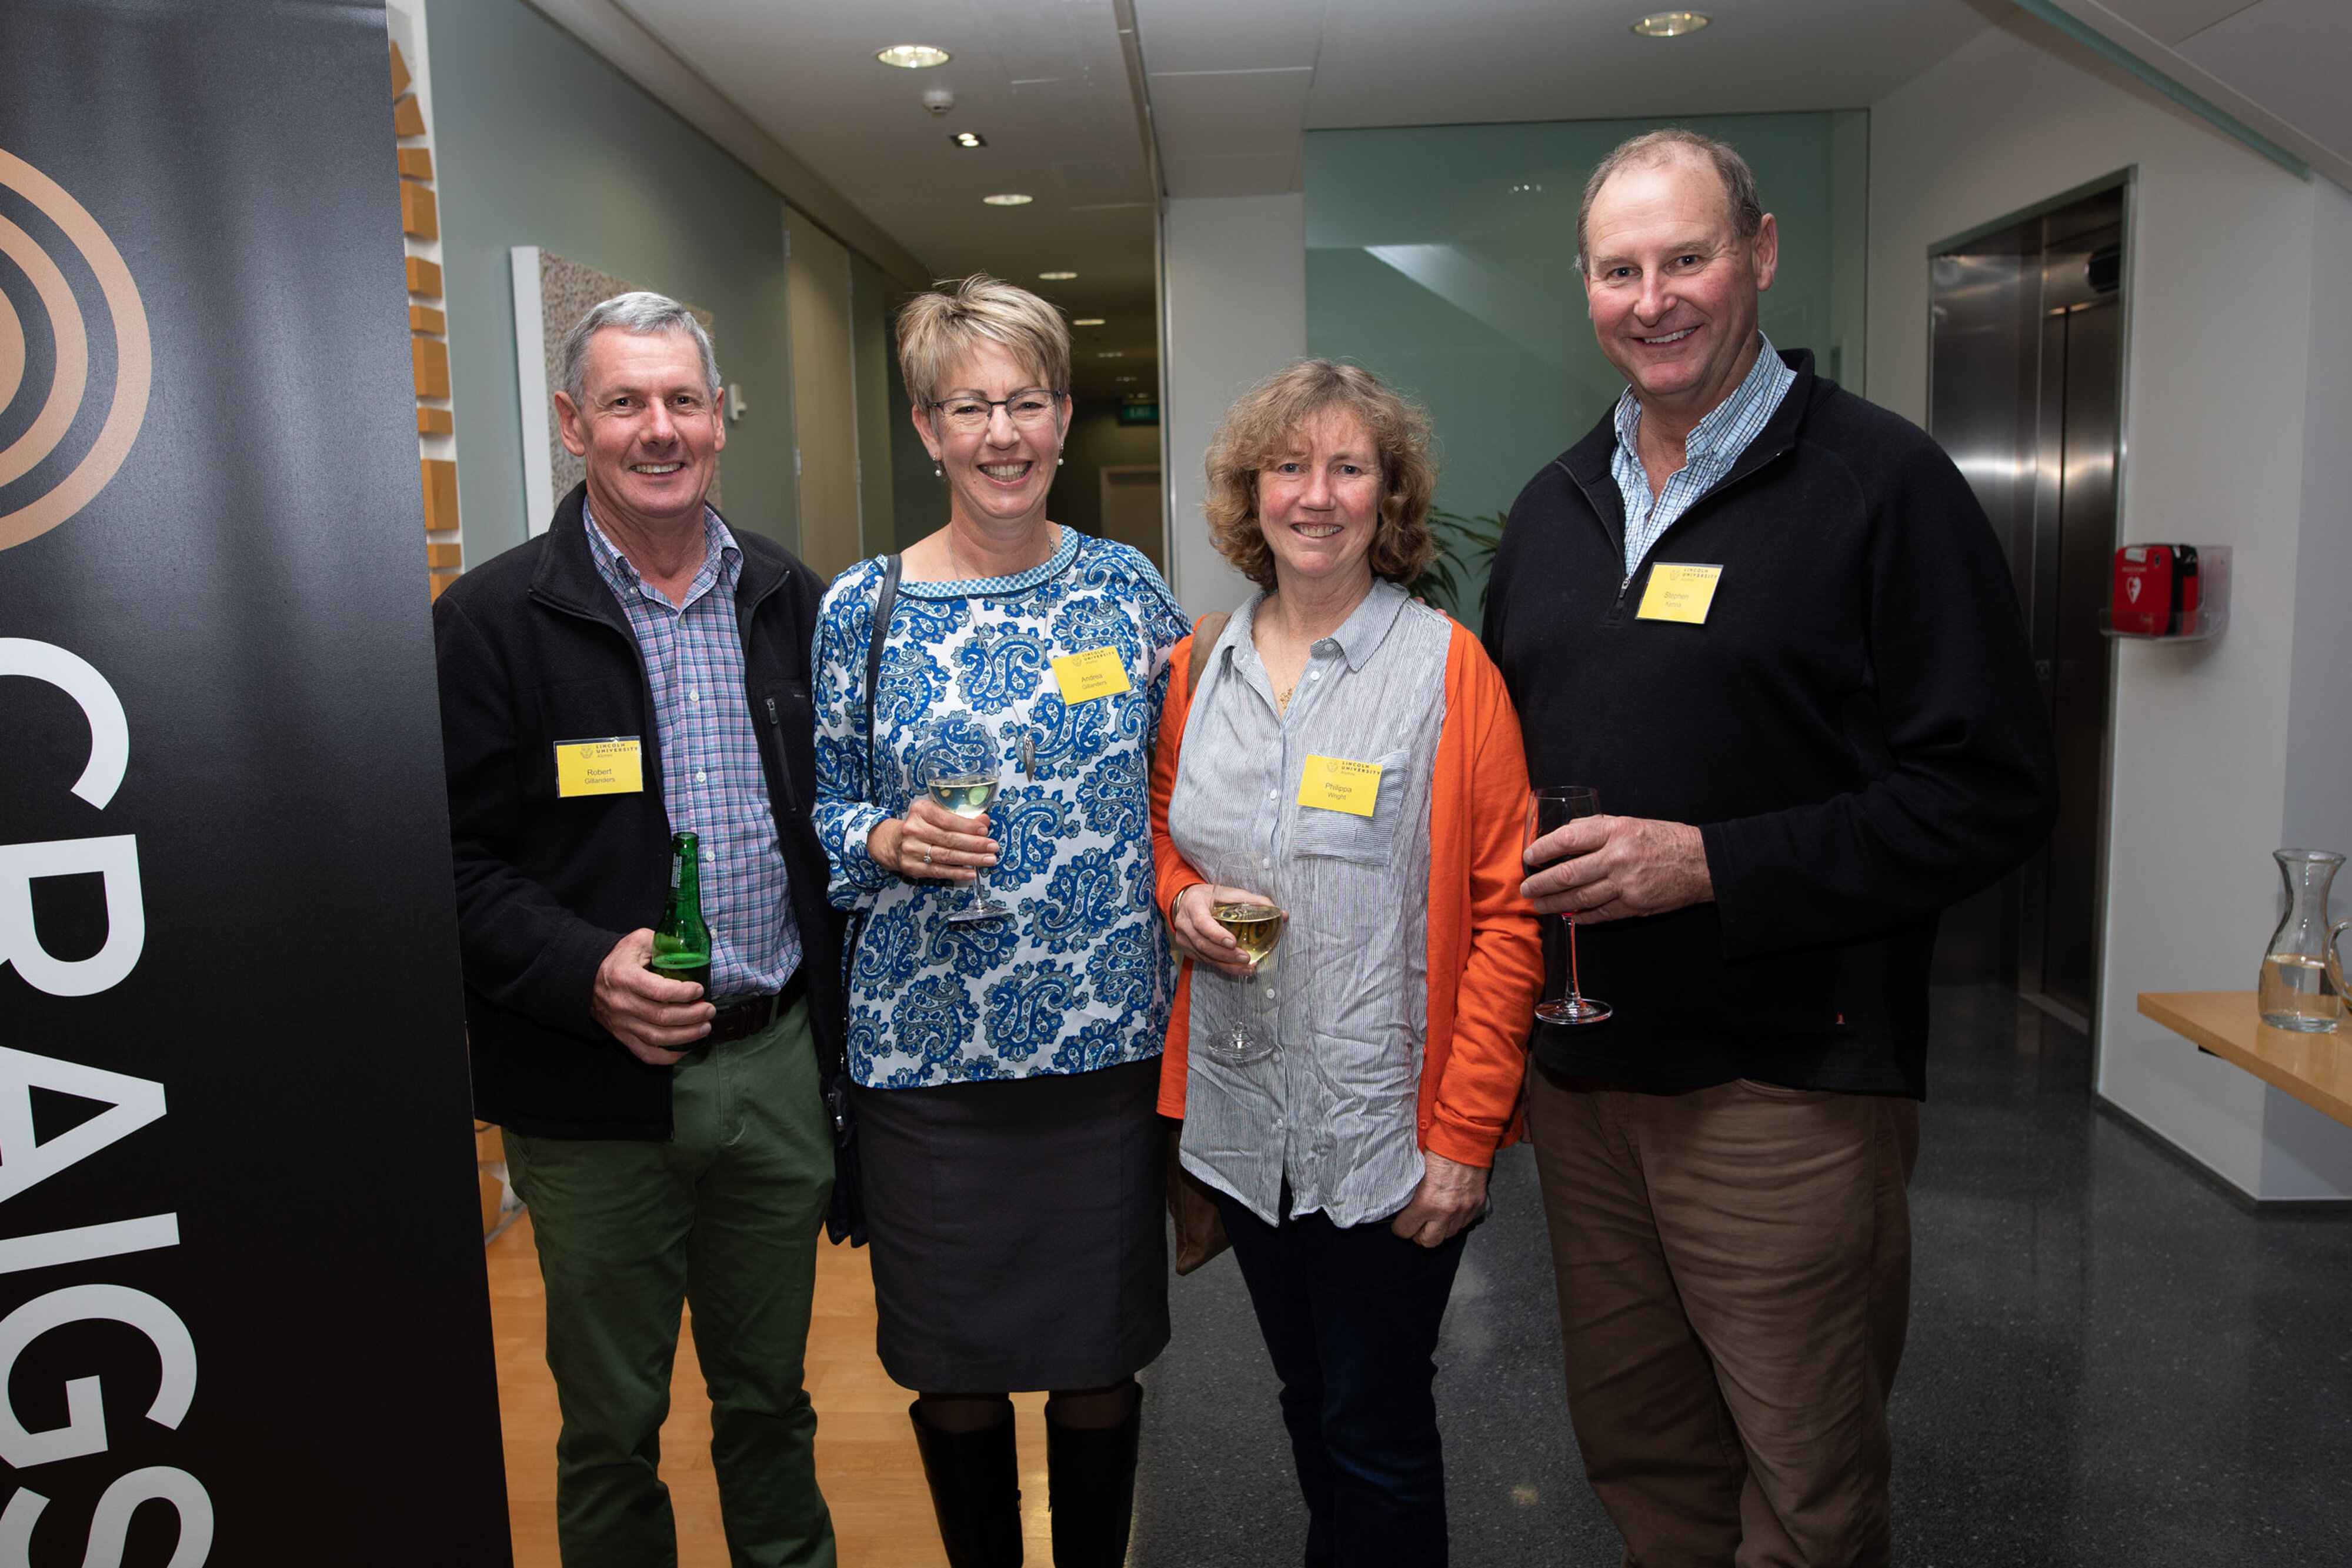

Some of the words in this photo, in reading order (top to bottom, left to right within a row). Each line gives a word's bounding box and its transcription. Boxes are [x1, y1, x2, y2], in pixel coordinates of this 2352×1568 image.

[1084, 652, 1115, 661] UNIVERSITY
[1082, 673, 1103, 682] Andrea
[1341, 766, 1380, 775] UNIVERSITY
[1325, 782, 1352, 793] Philippa
[1327, 792, 1346, 800] Wright
